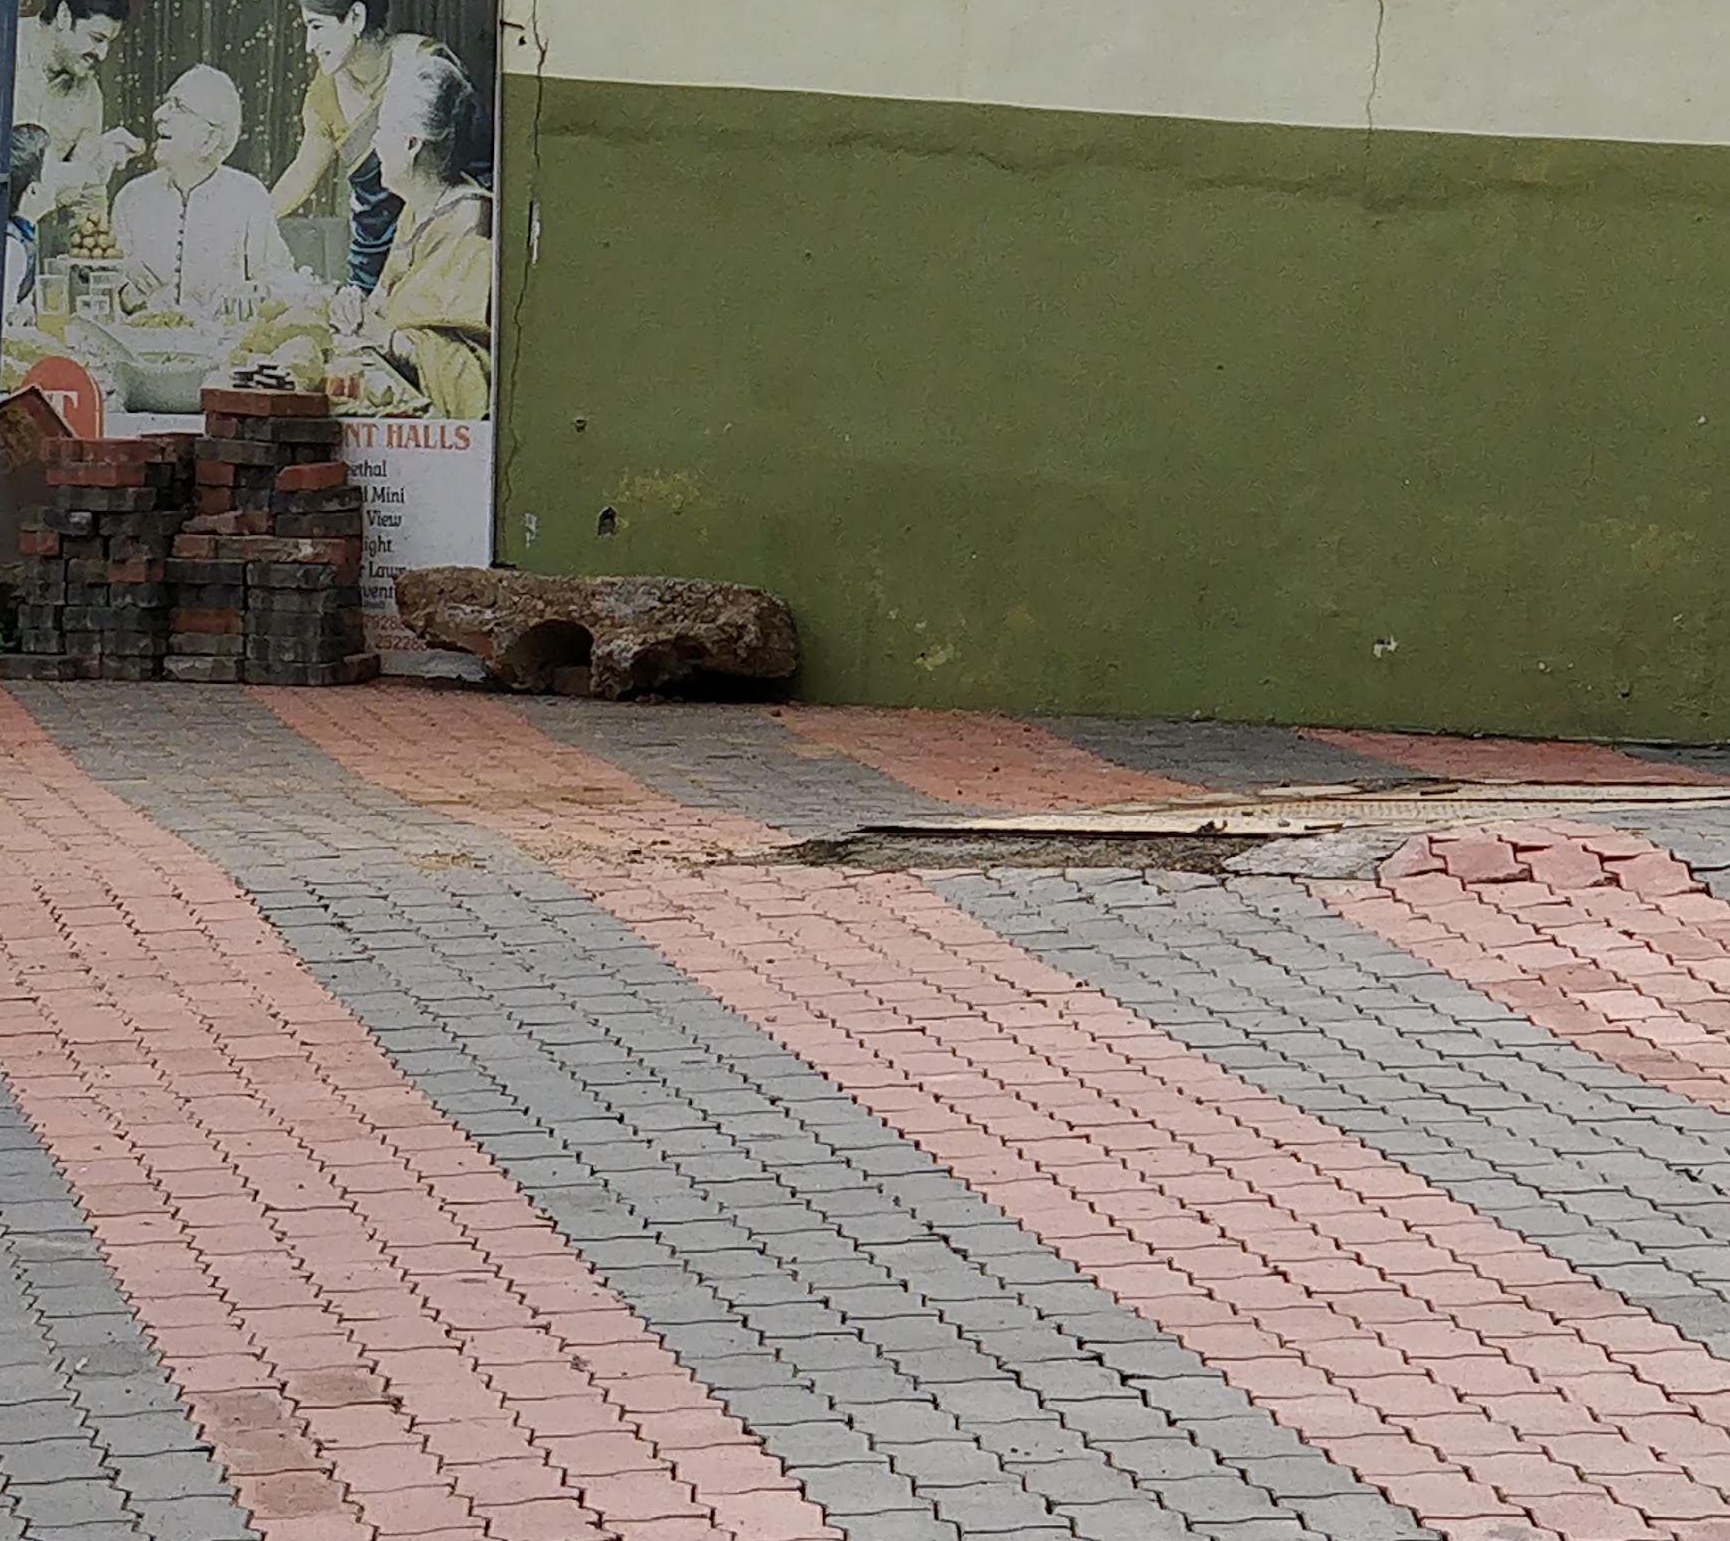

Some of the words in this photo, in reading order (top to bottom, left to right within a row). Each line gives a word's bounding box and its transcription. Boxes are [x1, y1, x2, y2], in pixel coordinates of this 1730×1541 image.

[386, 423, 472, 450] HALLS
[372, 485, 406, 505] Mini
[367, 511, 402, 528] View
